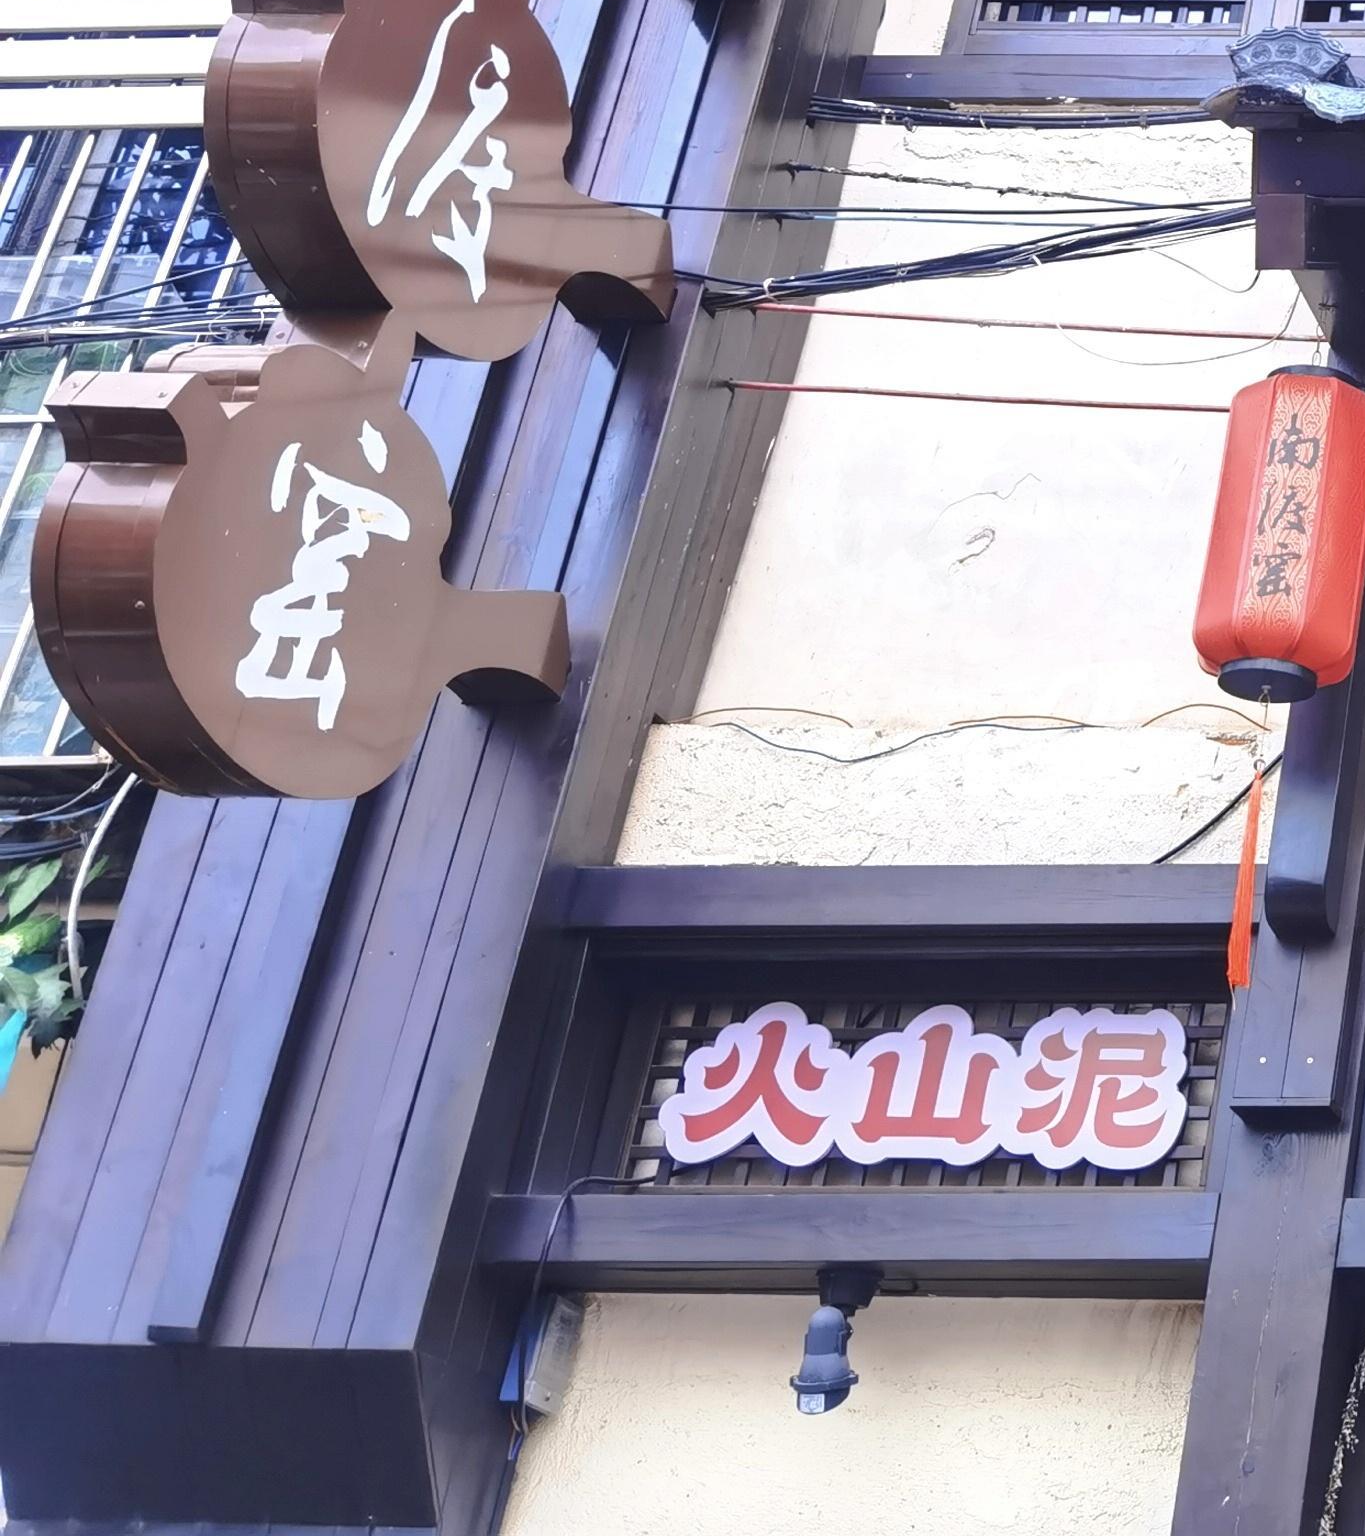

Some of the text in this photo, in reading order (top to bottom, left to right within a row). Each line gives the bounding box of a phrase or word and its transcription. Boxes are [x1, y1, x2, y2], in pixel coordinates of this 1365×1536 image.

[1254, 413, 1320, 598] 南渡窑
[679, 1019, 1168, 1150] 火山泥
